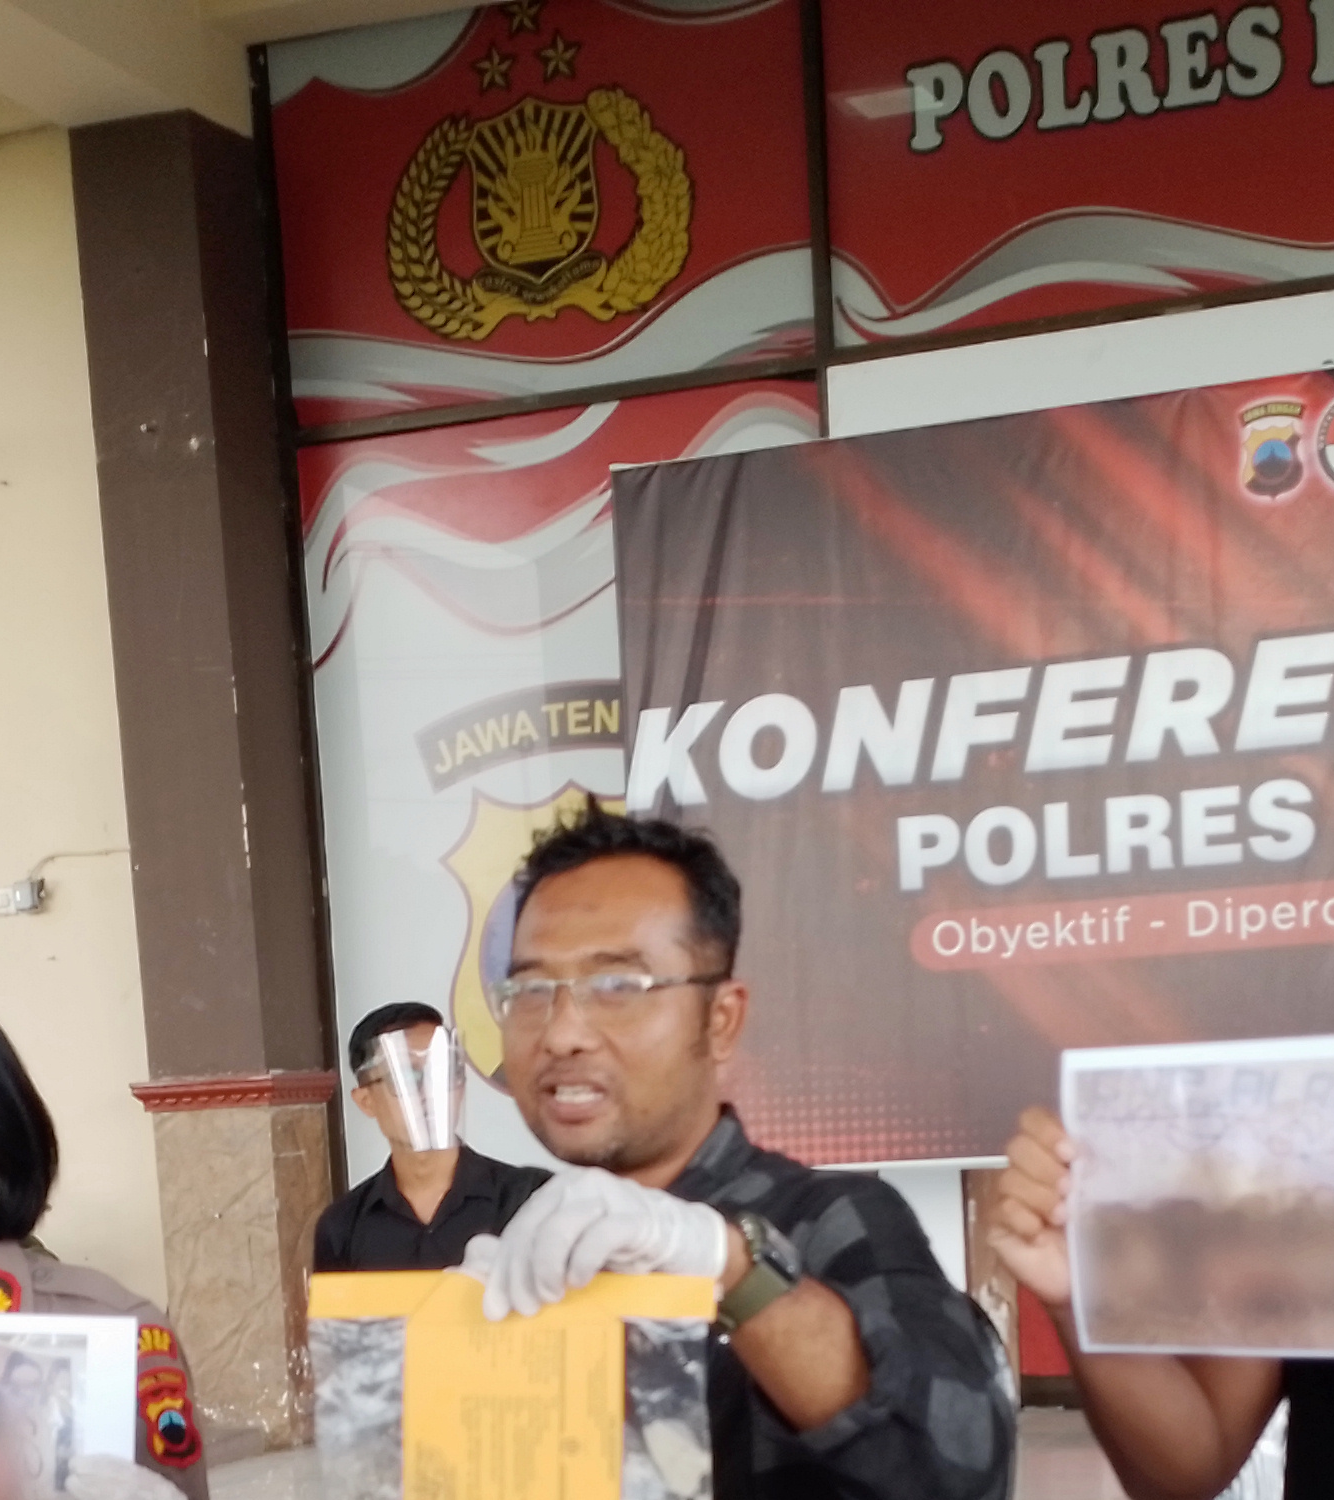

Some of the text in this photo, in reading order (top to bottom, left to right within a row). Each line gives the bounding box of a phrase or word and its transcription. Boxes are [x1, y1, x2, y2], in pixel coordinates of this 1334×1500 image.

[907, 8, 1283, 152] POLRES
[434, 698, 620, 775] JAWA TEN
[897, 777, 1317, 892] POLRES
[931, 904, 1131, 959] Obyektif
